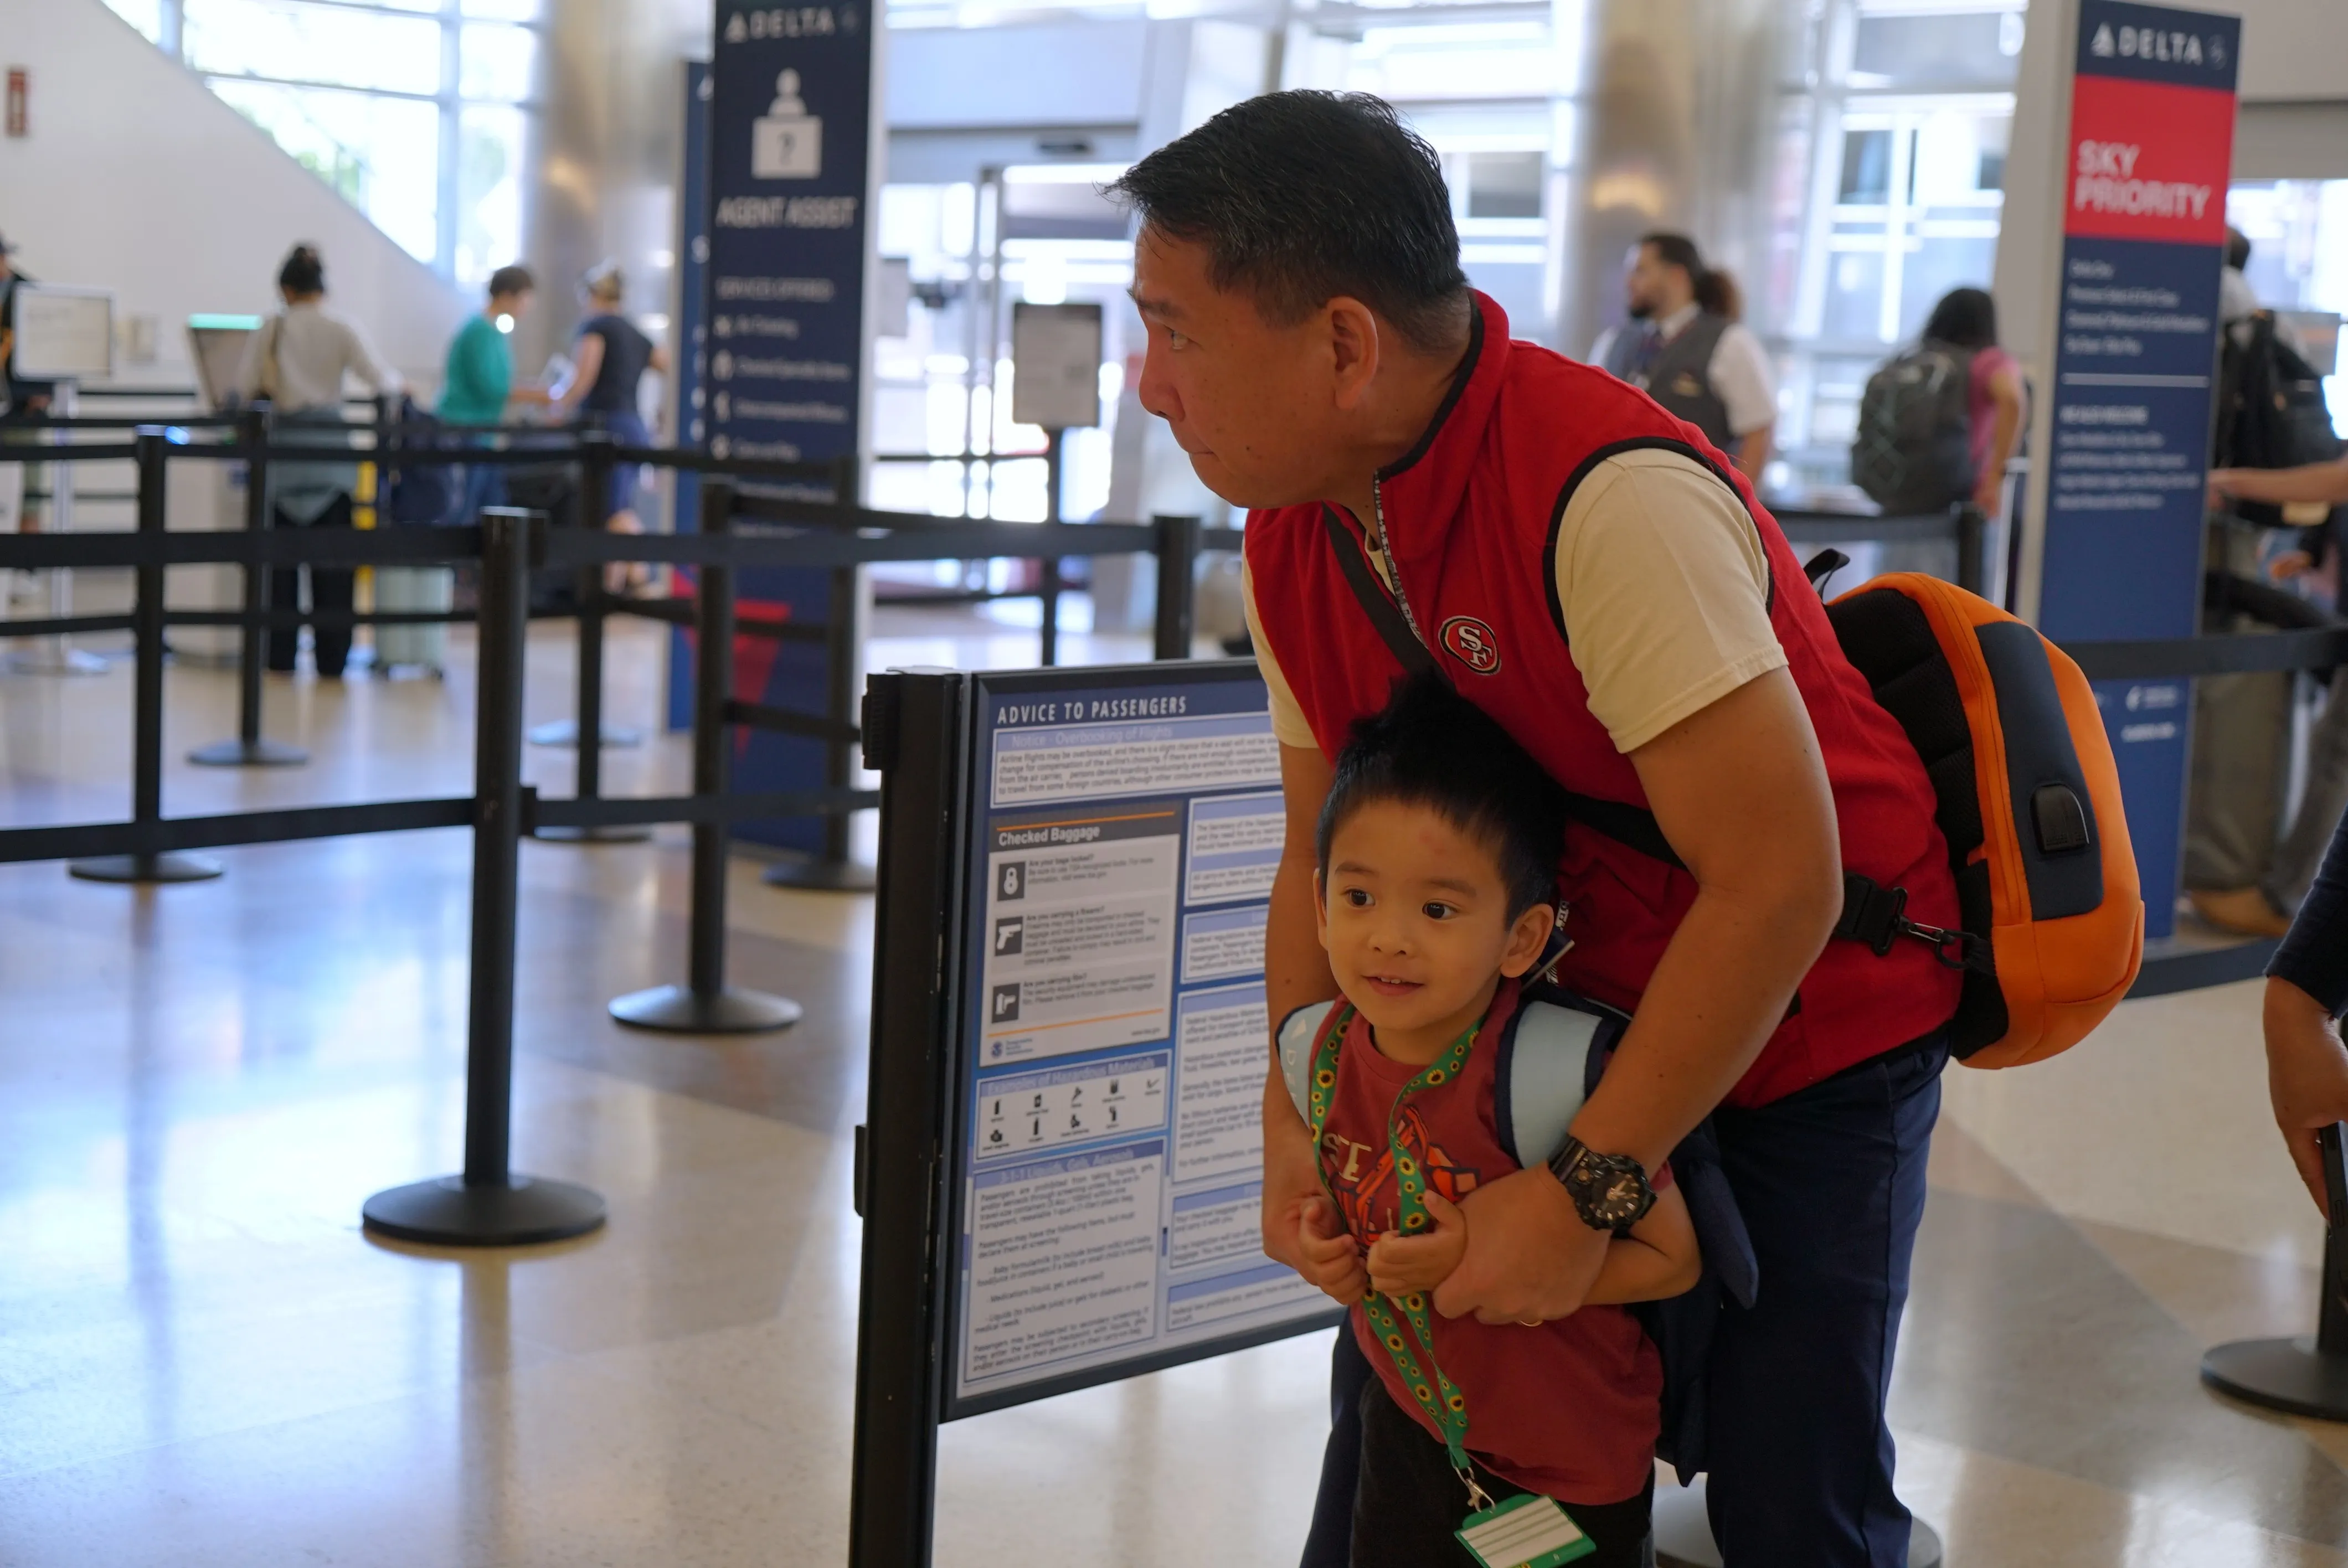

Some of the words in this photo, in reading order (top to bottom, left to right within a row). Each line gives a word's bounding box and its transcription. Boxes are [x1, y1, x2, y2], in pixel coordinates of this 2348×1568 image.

[750, 7, 835, 39] DELTA
[2118, 25, 2203, 65] DELTA
[2077, 140, 2141, 177] SKY
[716, 196, 785, 228] AGENT
[785, 196, 857, 229] ASSIST
[2074, 175, 2212, 220] PRIORITY
[1458, 625, 1492, 667] SF
[997, 704, 1056, 724] ADVICE
[1064, 702, 1084, 720] TO
[1091, 695, 1187, 718] PASSENGERS
[1012, 735, 1046, 748] Notice
[1055, 729, 1123, 746] Overbooking
[1125, 727, 1137, 741] of
[1139, 724, 1173, 741] Flights
[999, 829, 1048, 847] Checked
[1051, 825, 1100, 843] Baggage
[988, 1076, 1036, 1096] Examples
[1052, 1066, 1107, 1085] Hazardous
[1108, 1058, 1156, 1076] Materials
